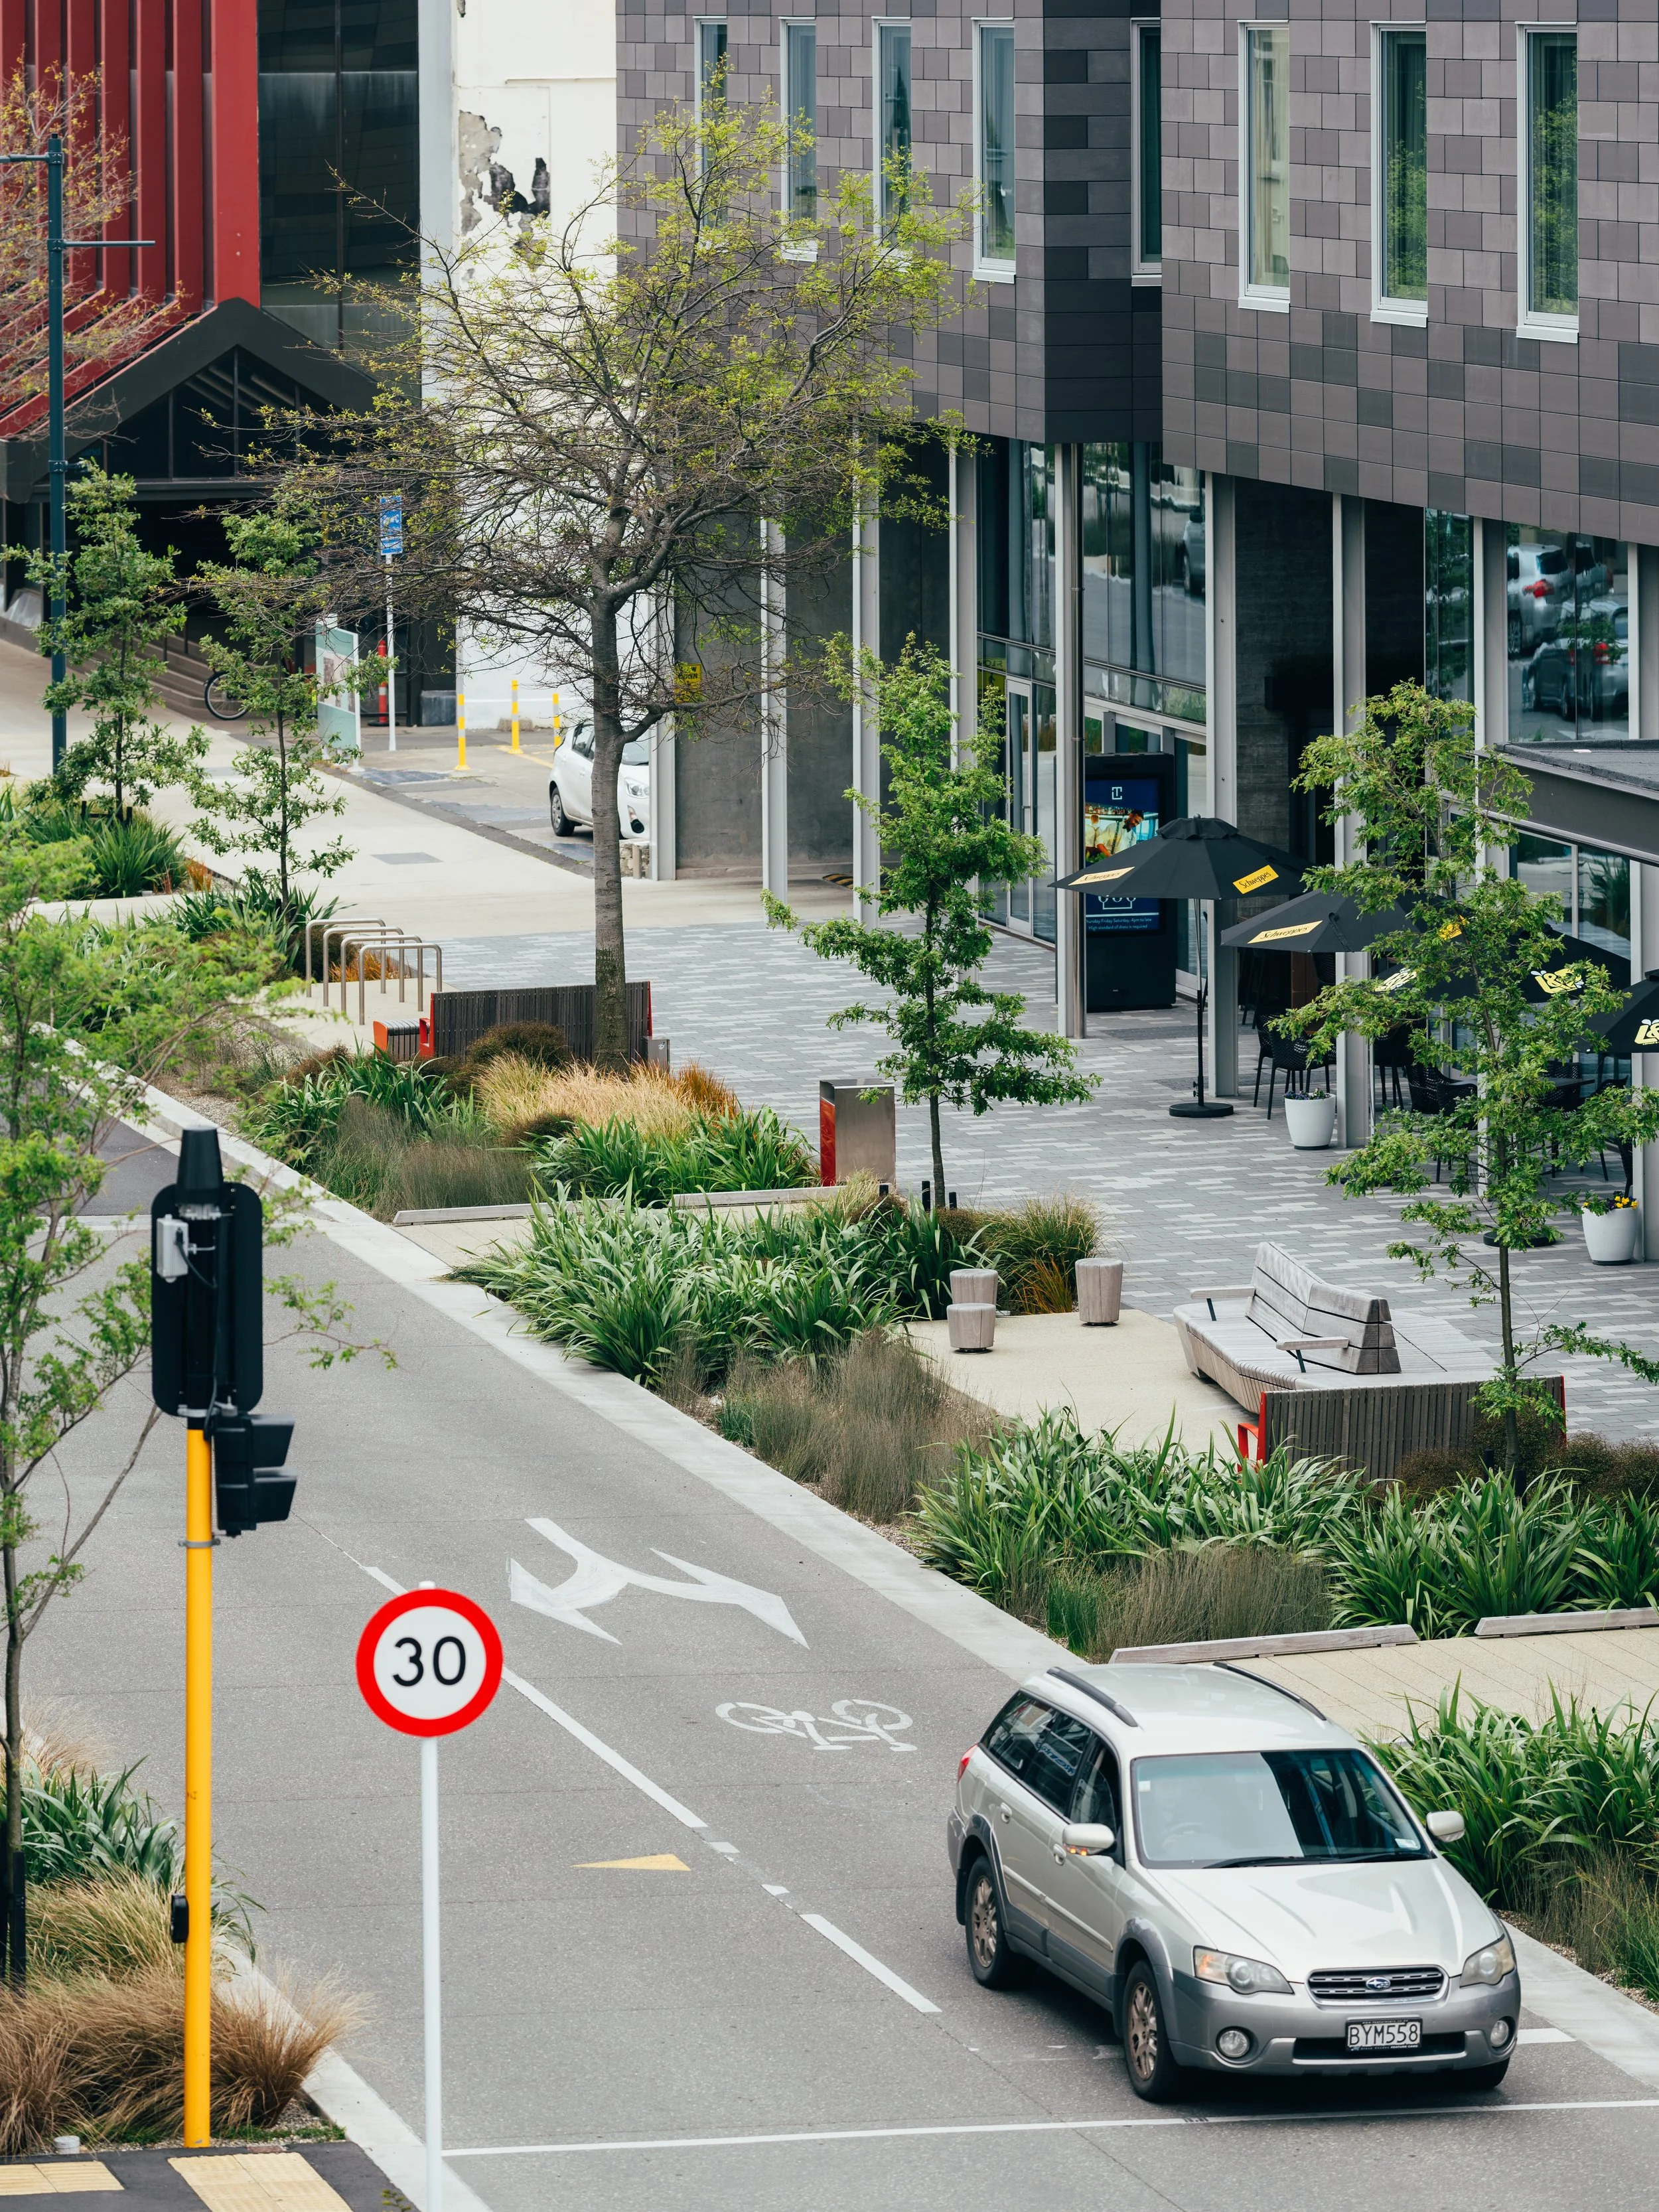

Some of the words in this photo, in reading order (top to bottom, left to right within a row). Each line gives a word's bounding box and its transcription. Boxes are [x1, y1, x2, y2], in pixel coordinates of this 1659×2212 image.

[1238, 872, 1271, 889] Schweppes
[1260, 926, 1310, 939] Schweppes
[393, 1636, 466, 1686] 30
[1349, 2024, 1418, 2045] BYM558
